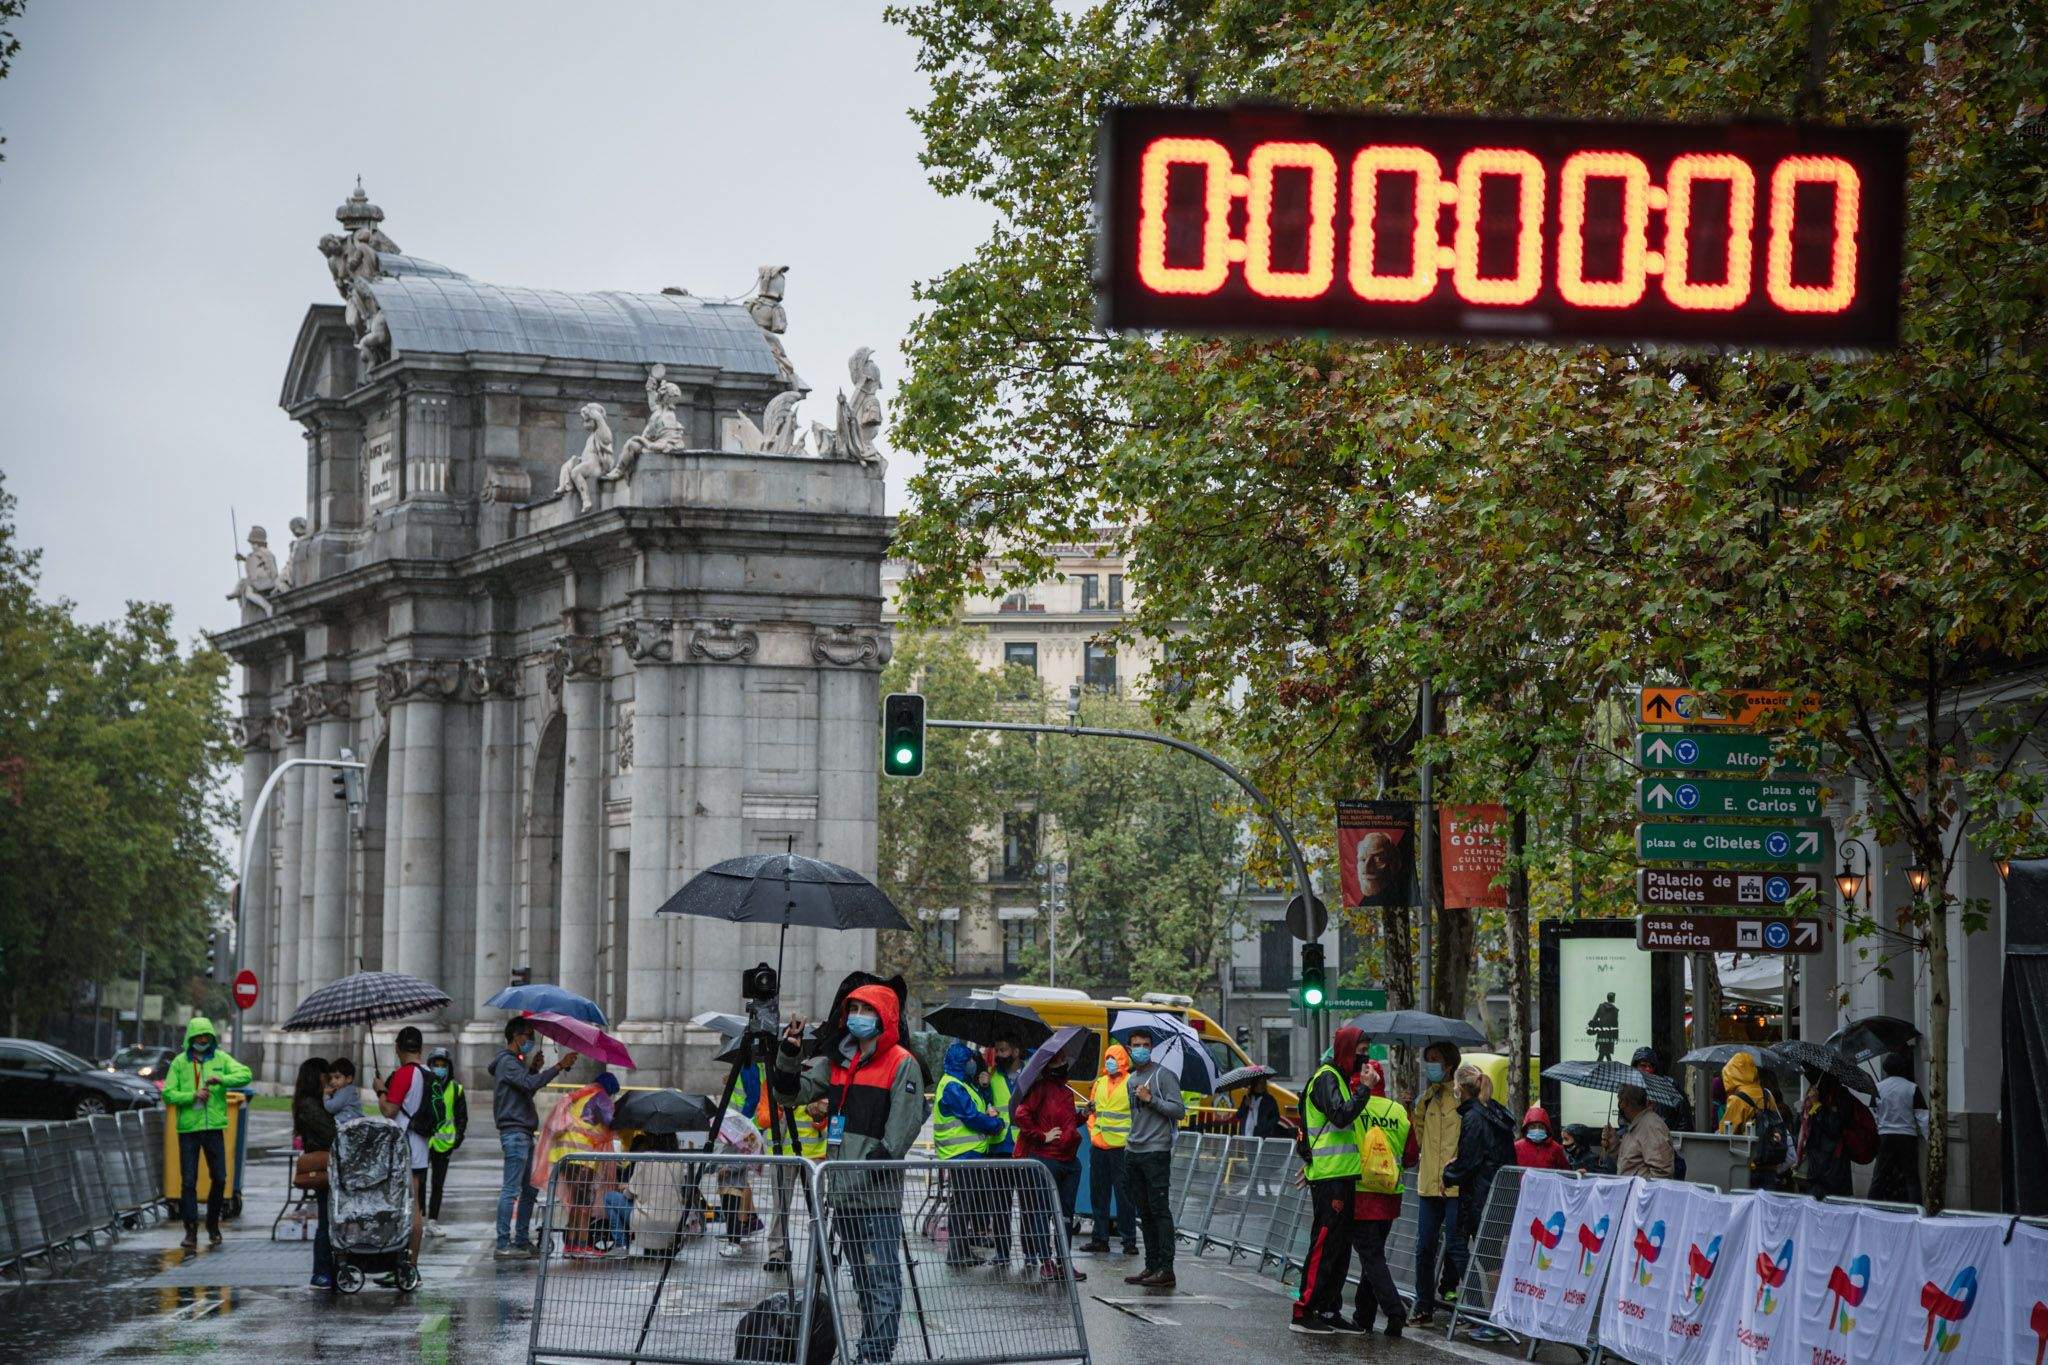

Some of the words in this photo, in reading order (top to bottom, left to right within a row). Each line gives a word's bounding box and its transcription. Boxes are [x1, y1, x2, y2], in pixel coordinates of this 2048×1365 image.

[1762, 785, 1792, 796] plaza
[1798, 786, 1816, 796] del
[1724, 798, 1738, 811] E.
[1747, 798, 1797, 812] Carlos
[1807, 799, 1816, 813] V
[1646, 836, 1676, 849] plaza
[1682, 838, 1697, 849] de
[1703, 835, 1761, 850] Cibeles
[1647, 872, 1704, 887] Palacio
[1713, 875, 1732, 888] de
[1647, 887, 1705, 901] Cibeles
[1647, 921, 1674, 930] casa
[1680, 920, 1694, 930] de
[1647, 932, 1711, 946] América
